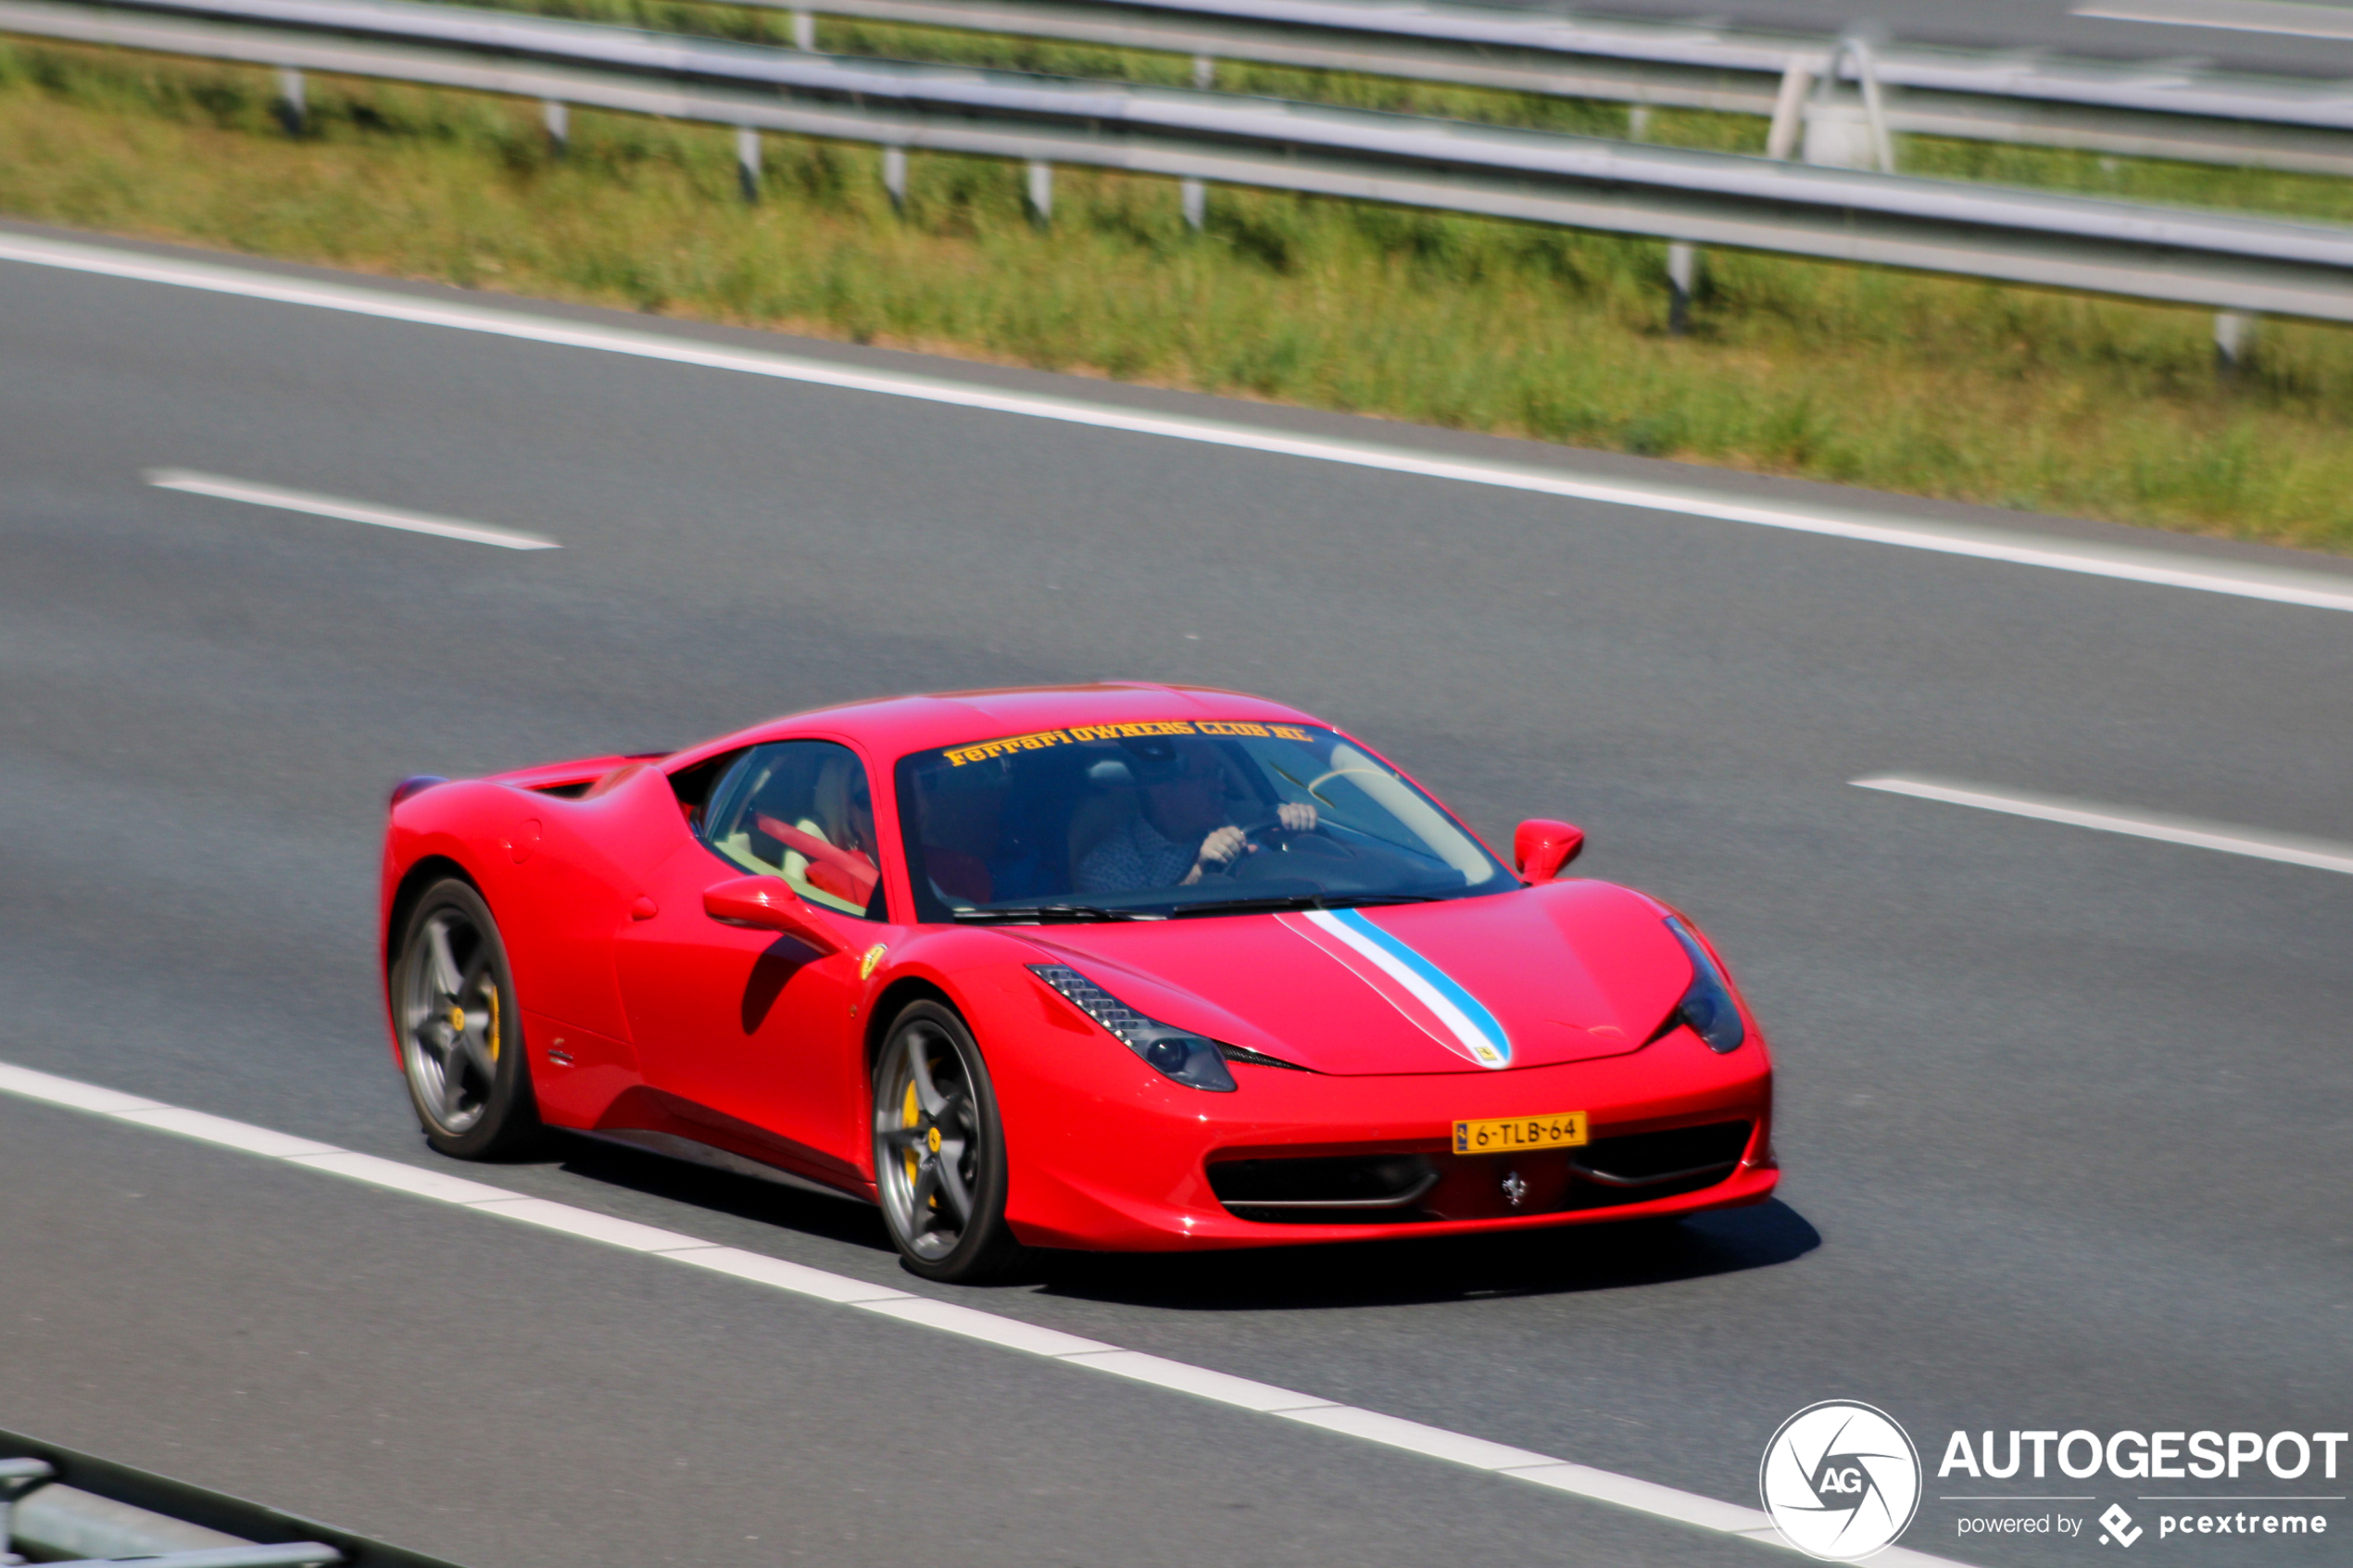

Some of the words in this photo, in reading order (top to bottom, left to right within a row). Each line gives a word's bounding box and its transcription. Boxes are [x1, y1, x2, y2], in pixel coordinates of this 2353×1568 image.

[943, 730, 1074, 767] Ferrari
[1068, 721, 1196, 742] OWNERS
[1194, 721, 1271, 737] CLUB
[1265, 725, 1314, 742] NL
[1476, 1118, 1577, 1146] 6-TLB-64
